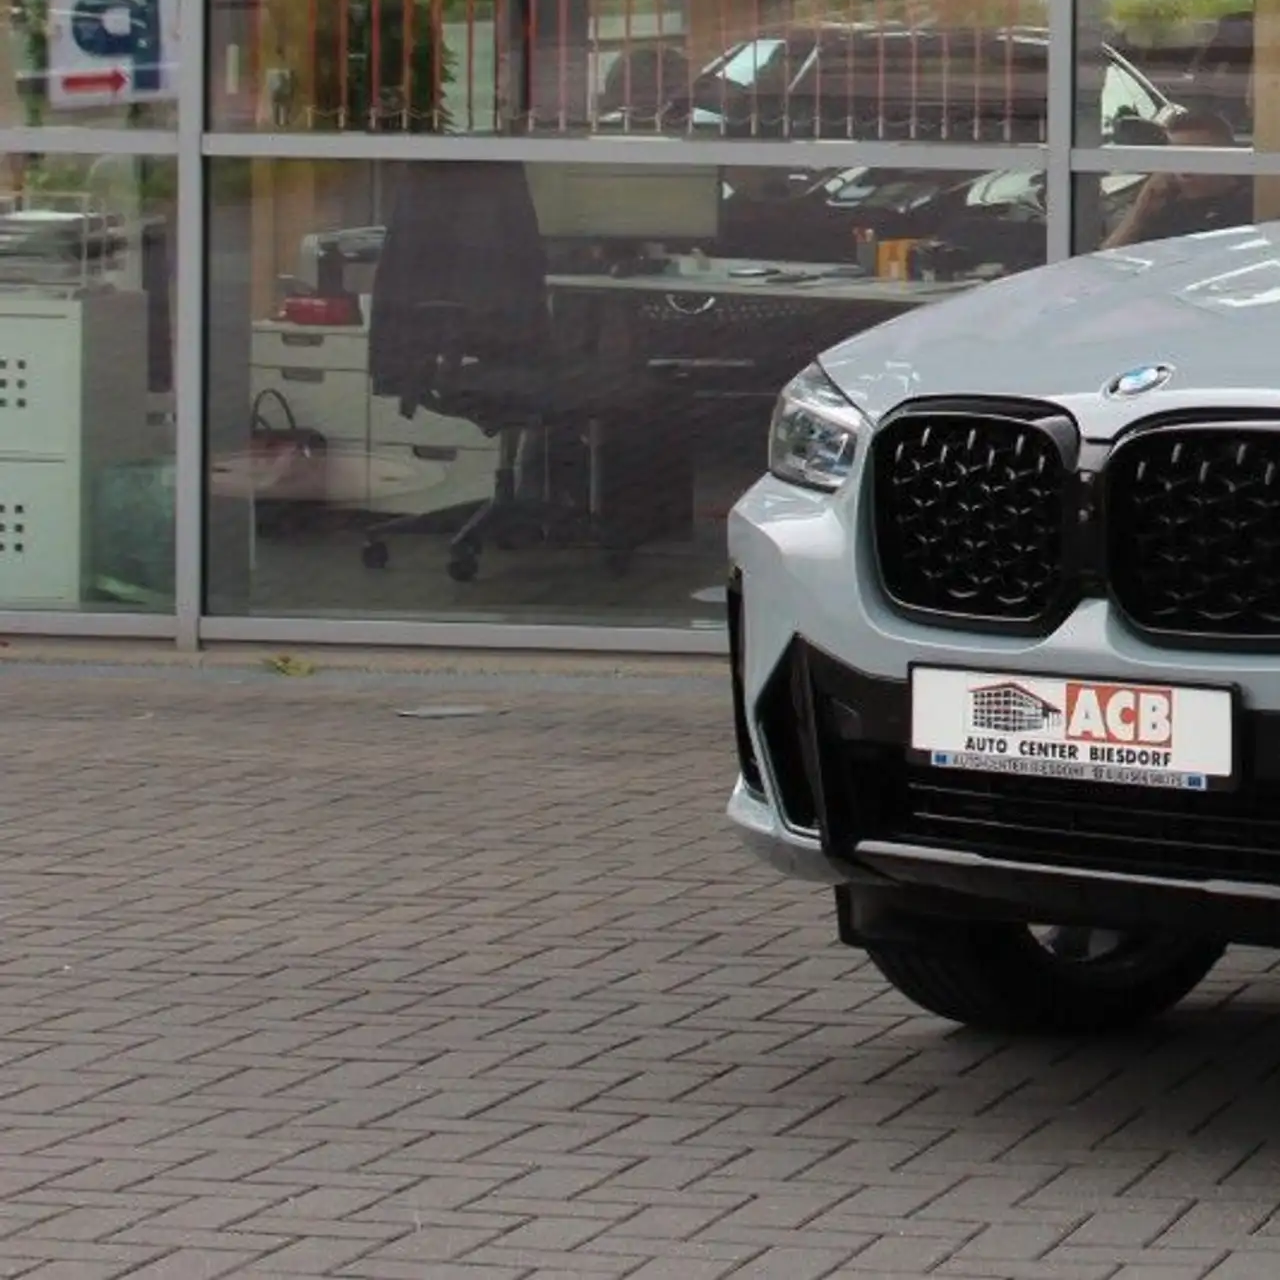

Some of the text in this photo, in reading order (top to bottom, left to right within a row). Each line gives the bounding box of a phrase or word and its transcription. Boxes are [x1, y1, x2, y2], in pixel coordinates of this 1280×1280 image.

[1068, 687, 1172, 743] ACB
[965, 736, 1008, 753] AUTO
[1019, 739, 1079, 761] CENTER
[1090, 745, 1172, 767] BIESDORF
